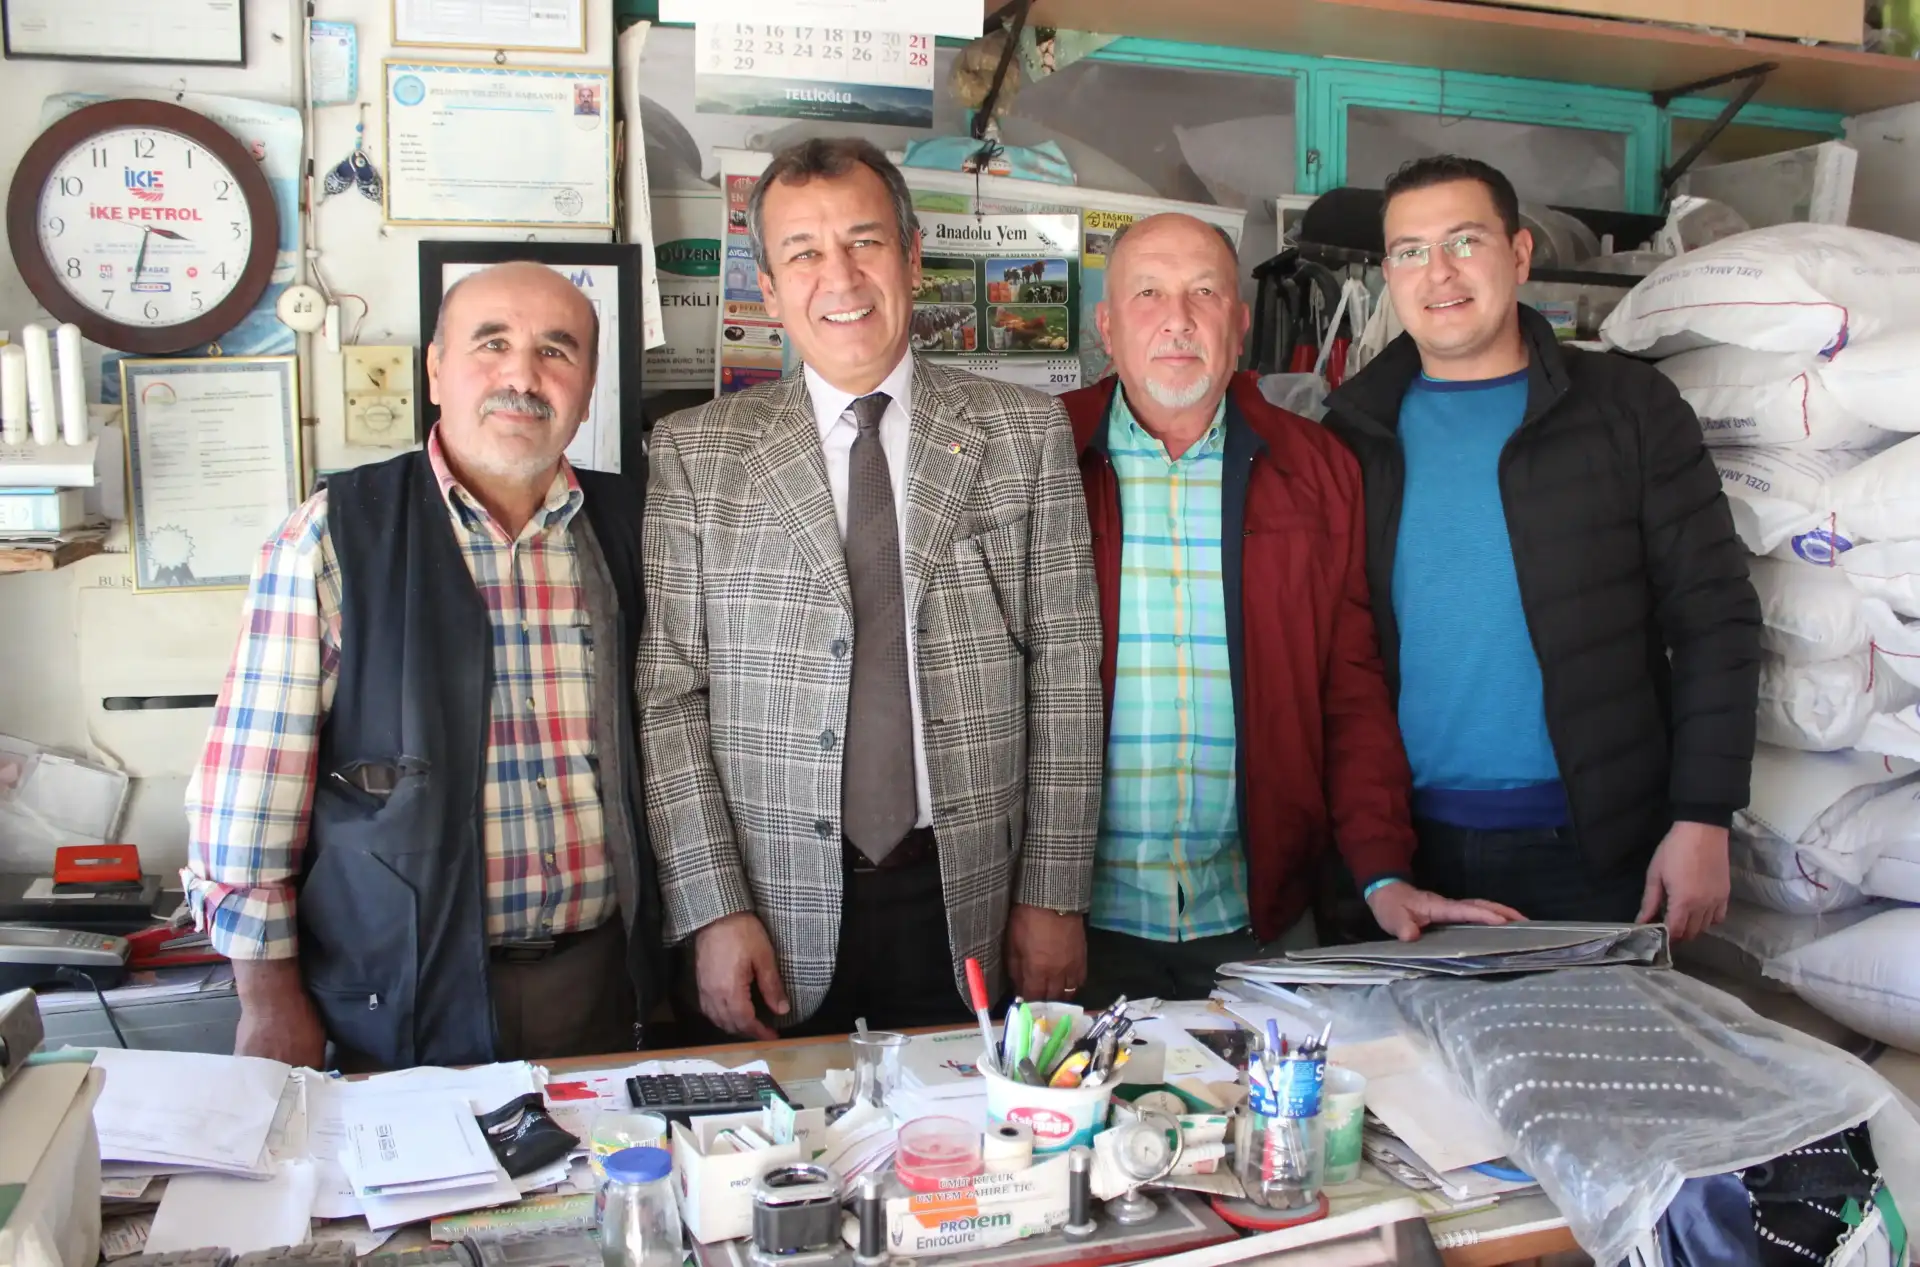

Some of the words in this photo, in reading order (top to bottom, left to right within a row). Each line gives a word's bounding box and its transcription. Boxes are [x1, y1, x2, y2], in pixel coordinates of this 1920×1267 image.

[764, 25, 785, 39] 16
[794, 27, 814, 40] 17
[823, 28, 844, 43] 18
[852, 30, 872, 44] 19
[881, 32, 900, 47] 20
[909, 34, 927, 49] 21
[733, 39, 754, 53] 22
[763, 41, 784, 56] 23
[793, 43, 813, 58] 24
[822, 45, 843, 60] 25
[852, 47, 872, 62] 26
[881, 49, 900, 63] 27
[909, 52, 928, 67] 28
[733, 57, 754, 71] 29
[92, 148, 107, 167] 11
[135, 137, 155, 158] 12
[187, 149, 192, 168] 1
[60, 176, 83, 197] 10
[213, 180, 230, 200] 2
[127, 206, 203, 221] PETROL
[49, 217, 65, 238] 9
[230, 222, 241, 240] 3
[997, 224, 1027, 246] Yem
[67, 257, 81, 278] 8
[212, 261, 229, 281] 4
[101, 290, 115, 310] 7
[144, 300, 159, 320] 6
[191, 291, 203, 310] 5
[1050, 374, 1077, 384] 2017
[1718, 466, 1744, 483] AMA
[916, 1194, 932, 1204] UN
[916, 1231, 976, 1250] Enrocure
